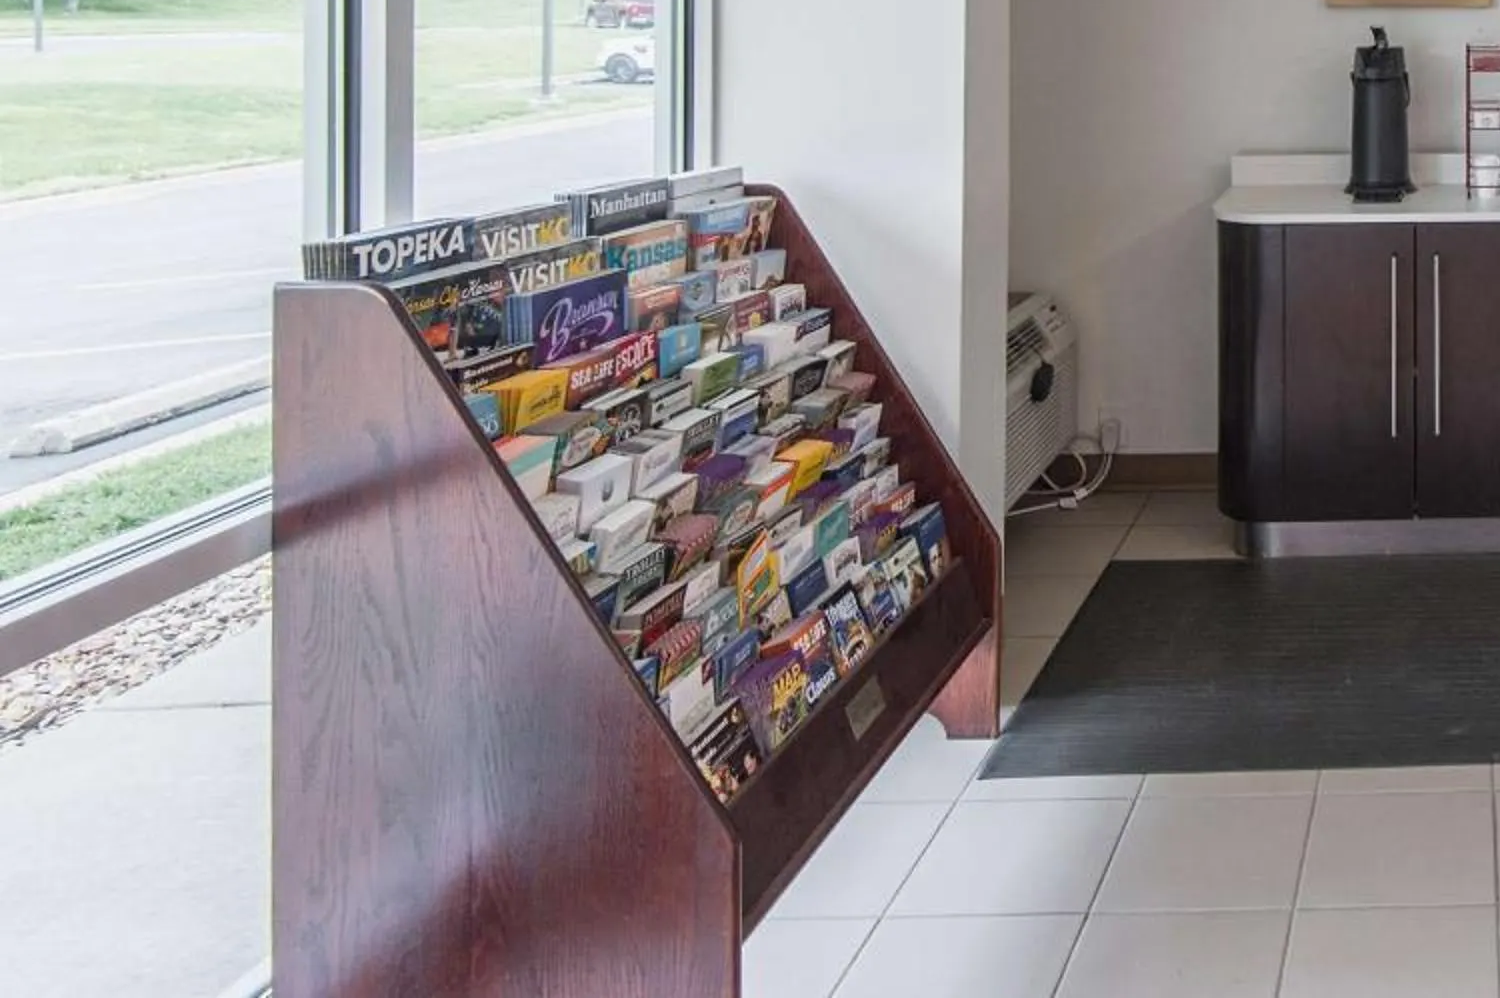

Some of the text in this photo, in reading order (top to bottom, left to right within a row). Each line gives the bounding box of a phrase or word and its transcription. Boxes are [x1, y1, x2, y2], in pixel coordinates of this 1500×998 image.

[590, 189, 667, 219] Manhattan
[352, 226, 465, 277] TOPEKA
[571, 366, 592, 390] SEA
